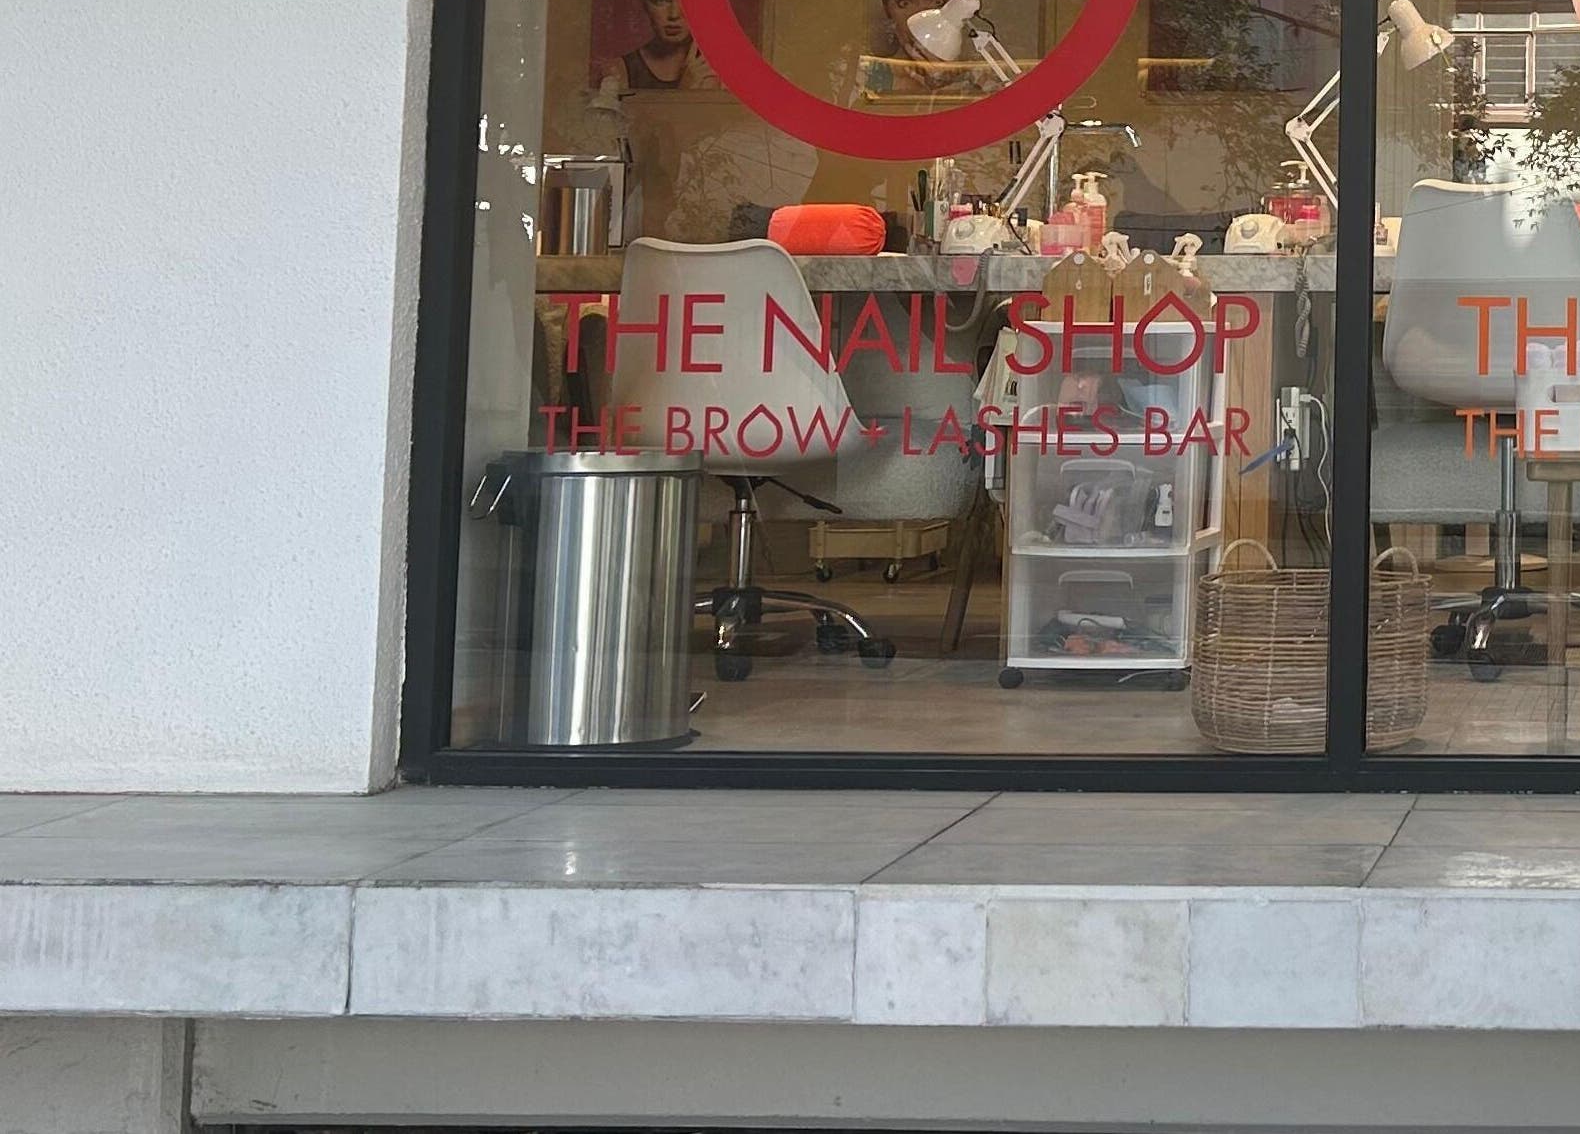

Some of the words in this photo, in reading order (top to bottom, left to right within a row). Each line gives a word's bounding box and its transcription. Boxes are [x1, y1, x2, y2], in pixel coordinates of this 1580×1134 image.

[549, 293, 724, 374] THE
[764, 293, 973, 374] NAIL
[1006, 290, 1262, 375] SHOP
[539, 405, 641, 456] THE
[665, 404, 852, 459] BROW
[903, 404, 1120, 456] LASHES
[1144, 406, 1252, 456] BAR
[1455, 408, 1559, 460] THE
